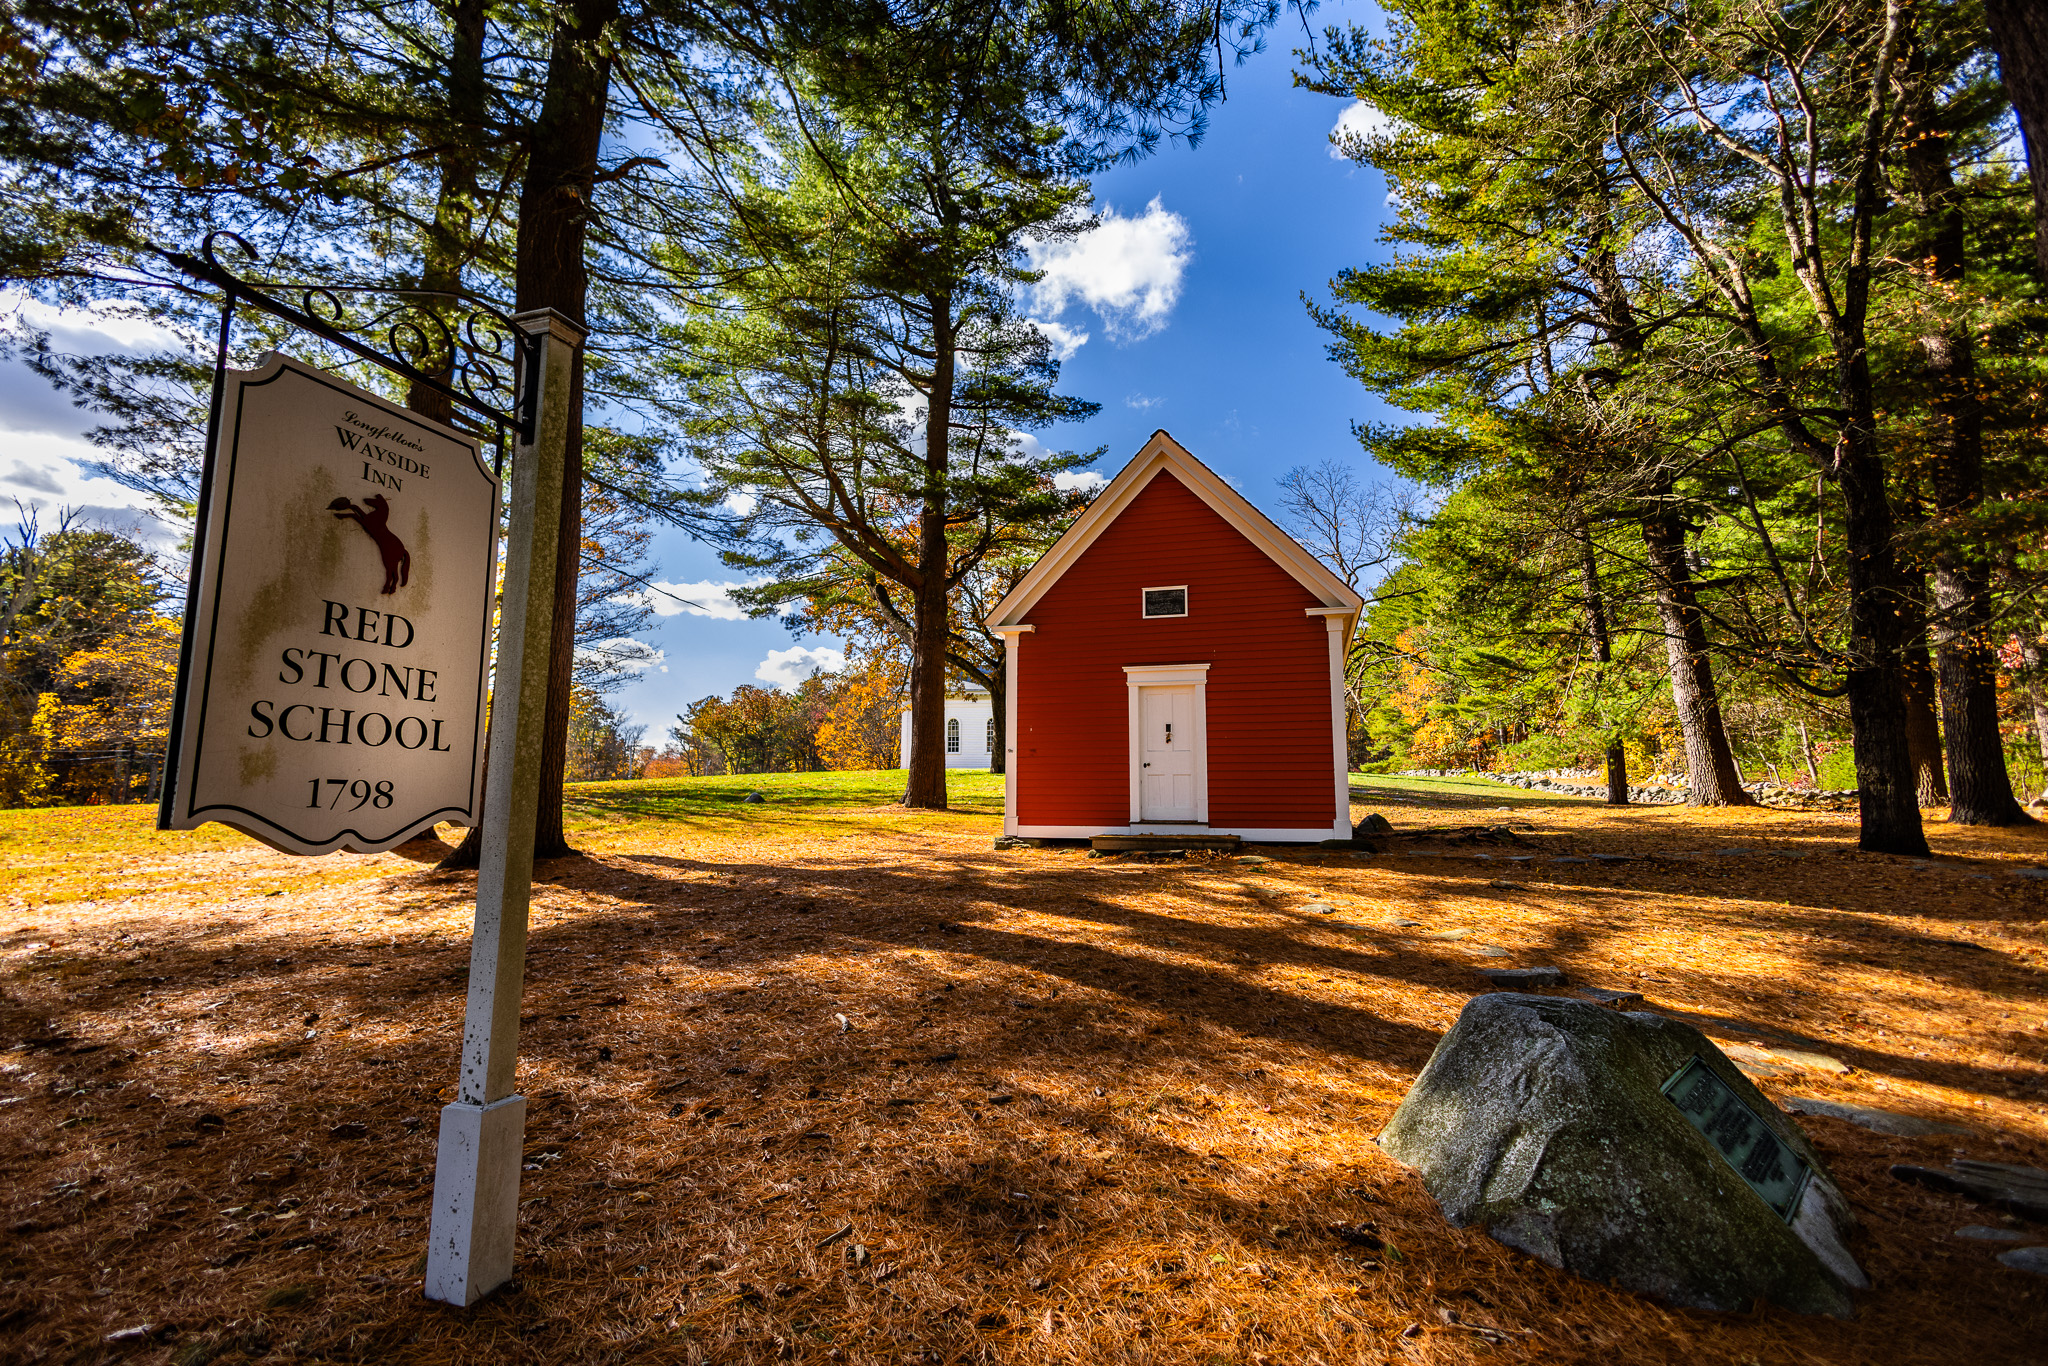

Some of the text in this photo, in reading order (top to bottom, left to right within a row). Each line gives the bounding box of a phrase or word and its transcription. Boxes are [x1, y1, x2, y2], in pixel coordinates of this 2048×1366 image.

[333, 424, 430, 479] WAYSIDE
[361, 460, 403, 493] INN
[319, 600, 414, 649] RED
[279, 647, 438, 702] STONE
[247, 700, 451, 752] SCHOOL
[306, 778, 394, 812] 1798
